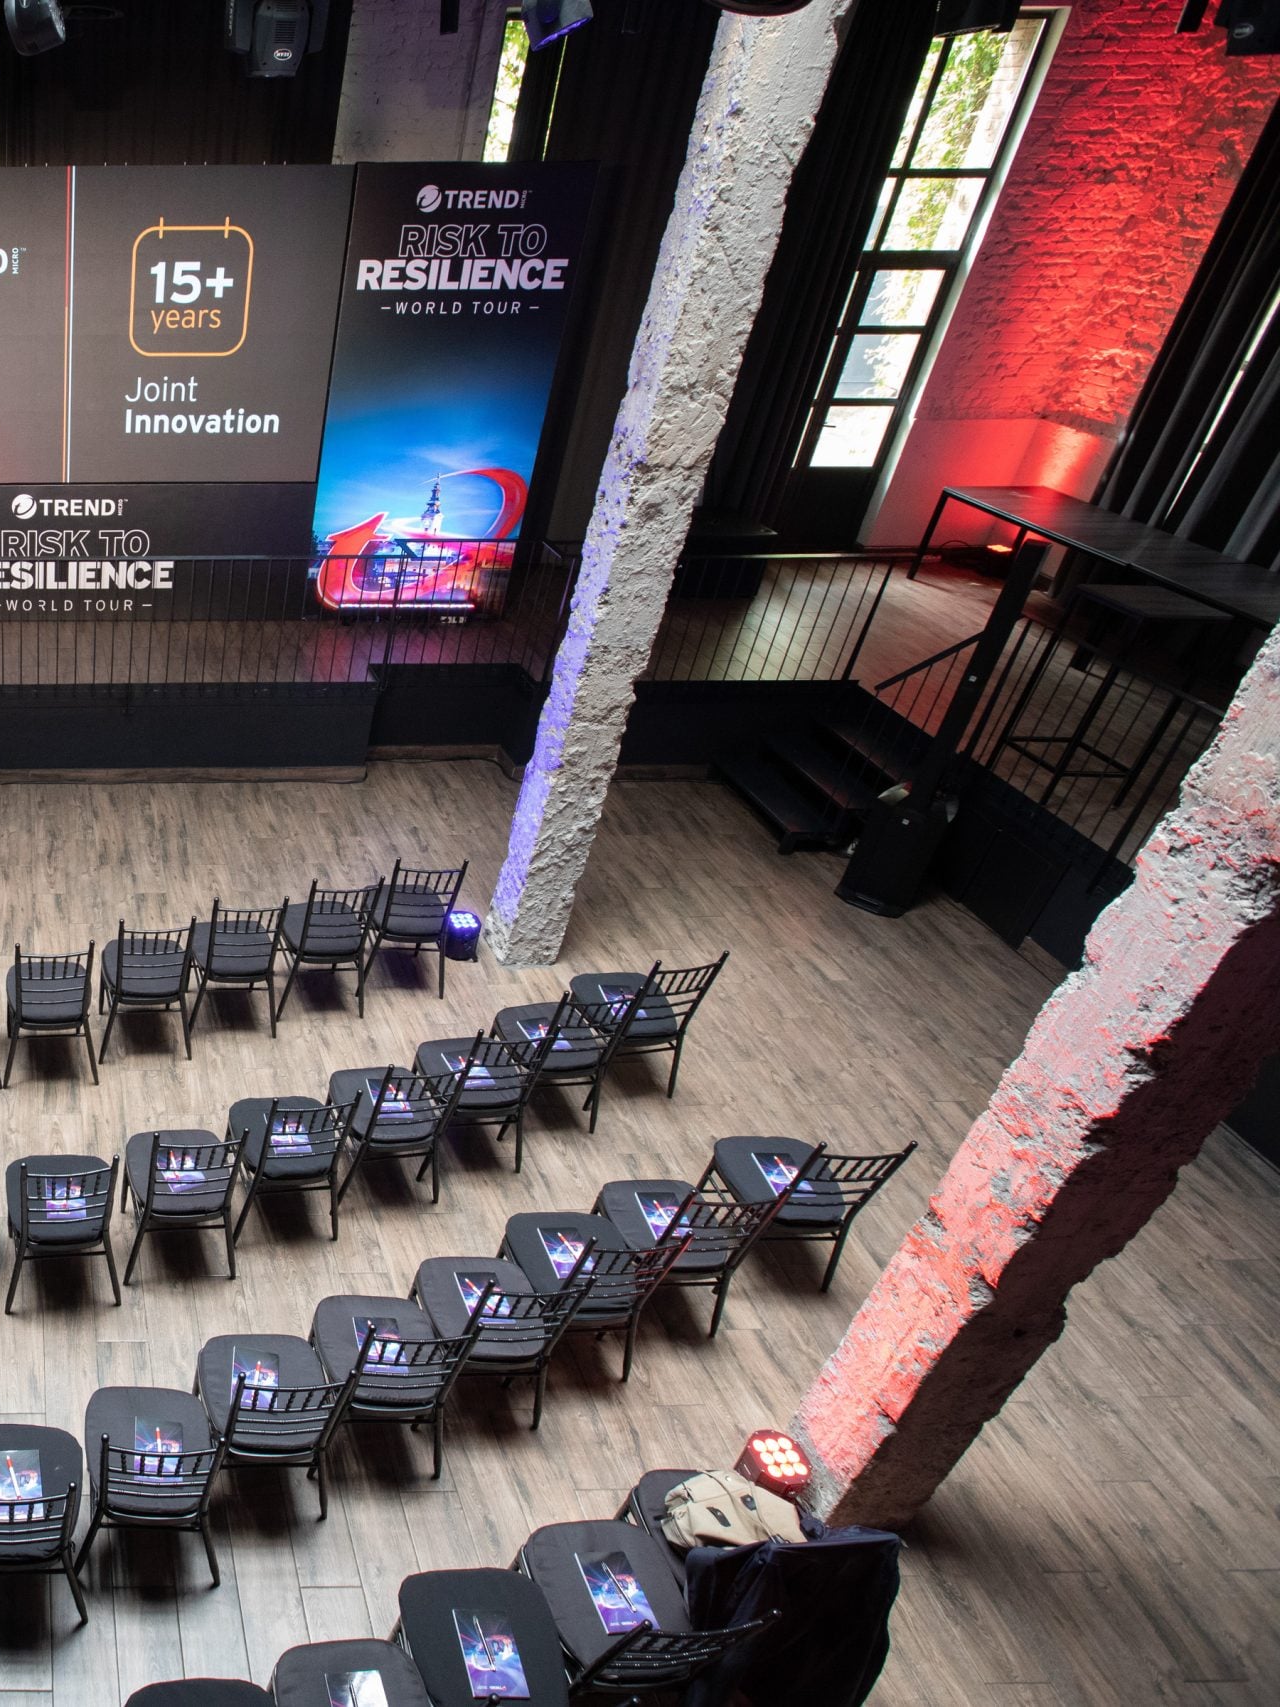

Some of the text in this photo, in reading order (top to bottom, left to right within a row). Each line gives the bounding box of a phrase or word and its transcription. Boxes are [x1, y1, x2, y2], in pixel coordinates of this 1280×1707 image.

[445, 190, 520, 208] TREND
[398, 224, 548, 257] RISK TO
[11, 247, 19, 275] MICRO
[356, 259, 569, 290] RESILIENCE
[151, 261, 234, 303] 15+
[151, 305, 222, 334] years
[395, 301, 521, 315] WORLD TOUR
[125, 376, 198, 403] Joint
[125, 408, 280, 434] Innovation
[39, 499, 116, 516] TREND
[1, 530, 150, 557] RISK TO
[6, 600, 133, 611] WORLD TOUR
